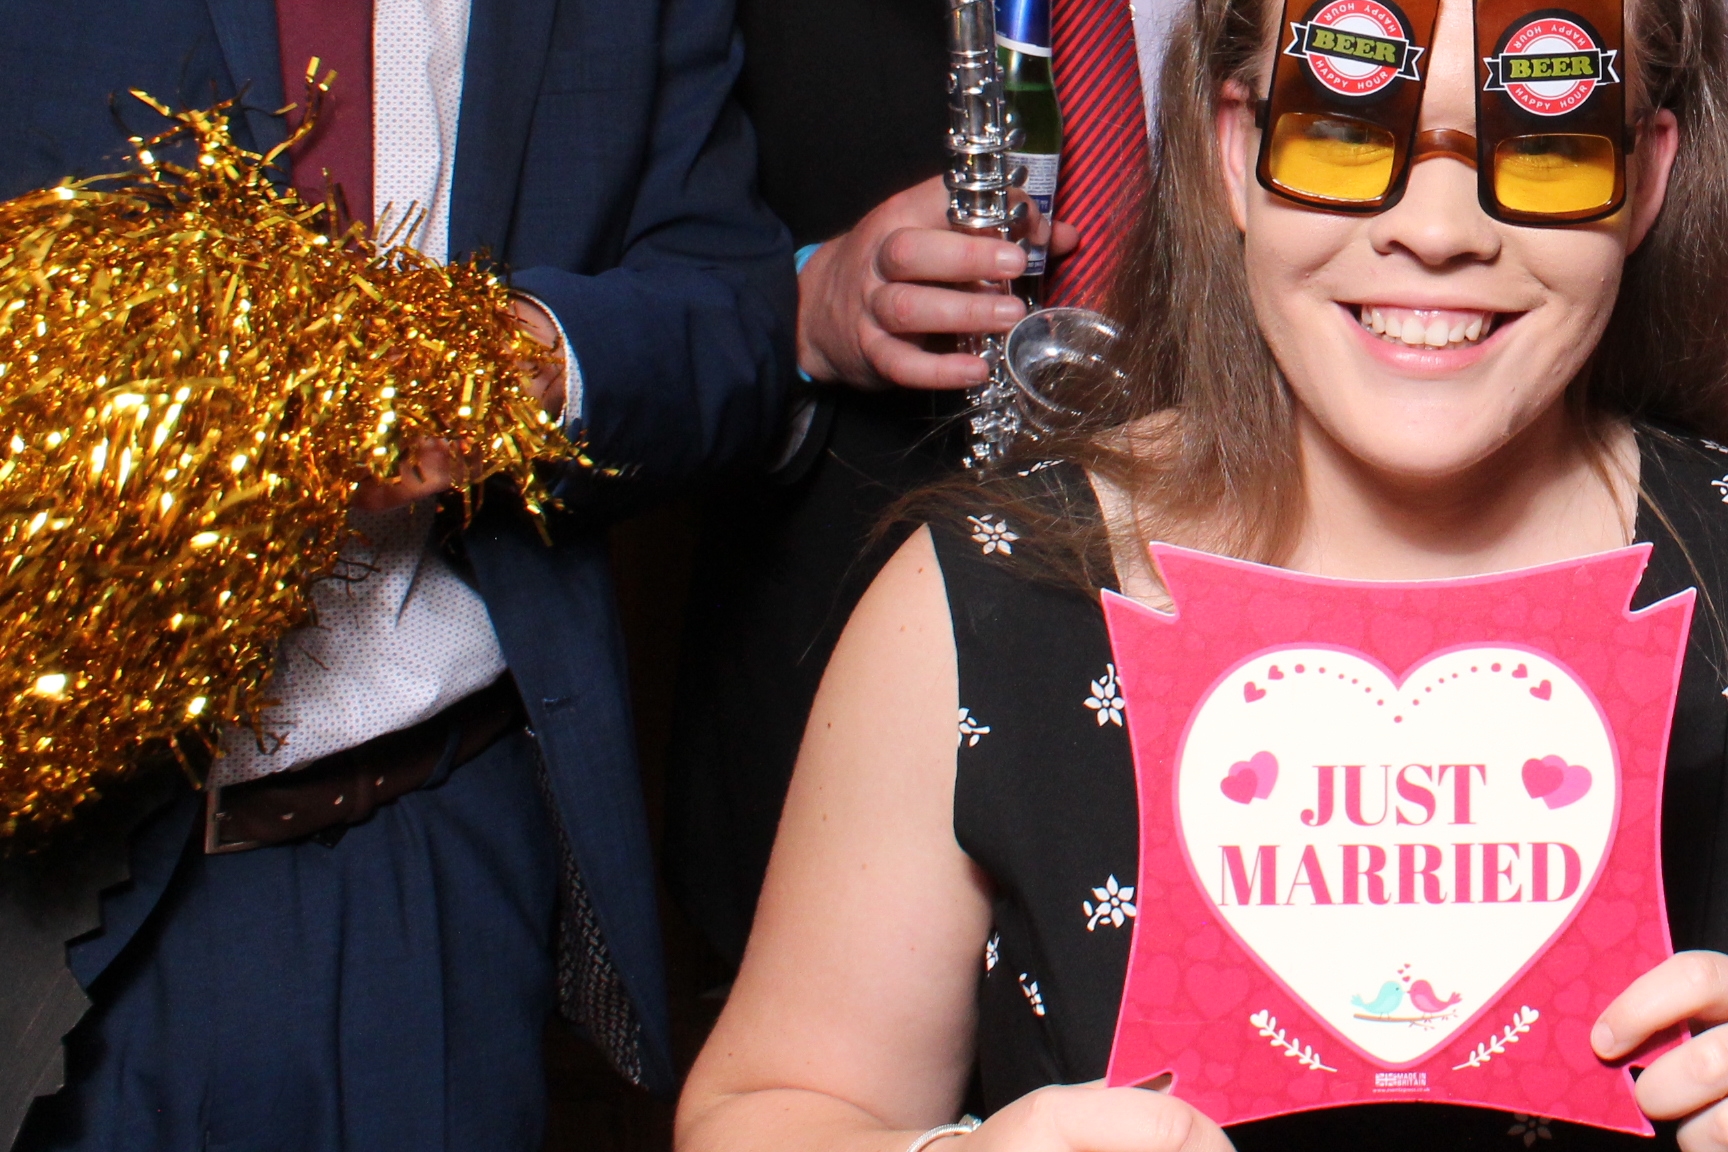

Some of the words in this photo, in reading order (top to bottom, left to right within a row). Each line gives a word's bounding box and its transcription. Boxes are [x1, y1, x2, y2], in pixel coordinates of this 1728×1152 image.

[1324, 2, 1355, 21] HOUR
[1364, 5, 1396, 33] HAPPY
[1312, 29, 1396, 64] BEER
[1513, 26, 1542, 49] HOUR
[1551, 24, 1586, 46] HAPPY
[1315, 60, 1349, 88] HAPPY
[1357, 71, 1388, 89] HOUR
[1509, 56, 1594, 78] BEER
[1515, 88, 1551, 110] HAPPY
[1560, 85, 1588, 108] HOUR
[1300, 763, 1486, 827] JUST
[1217, 841, 1582, 907] MARRIED
